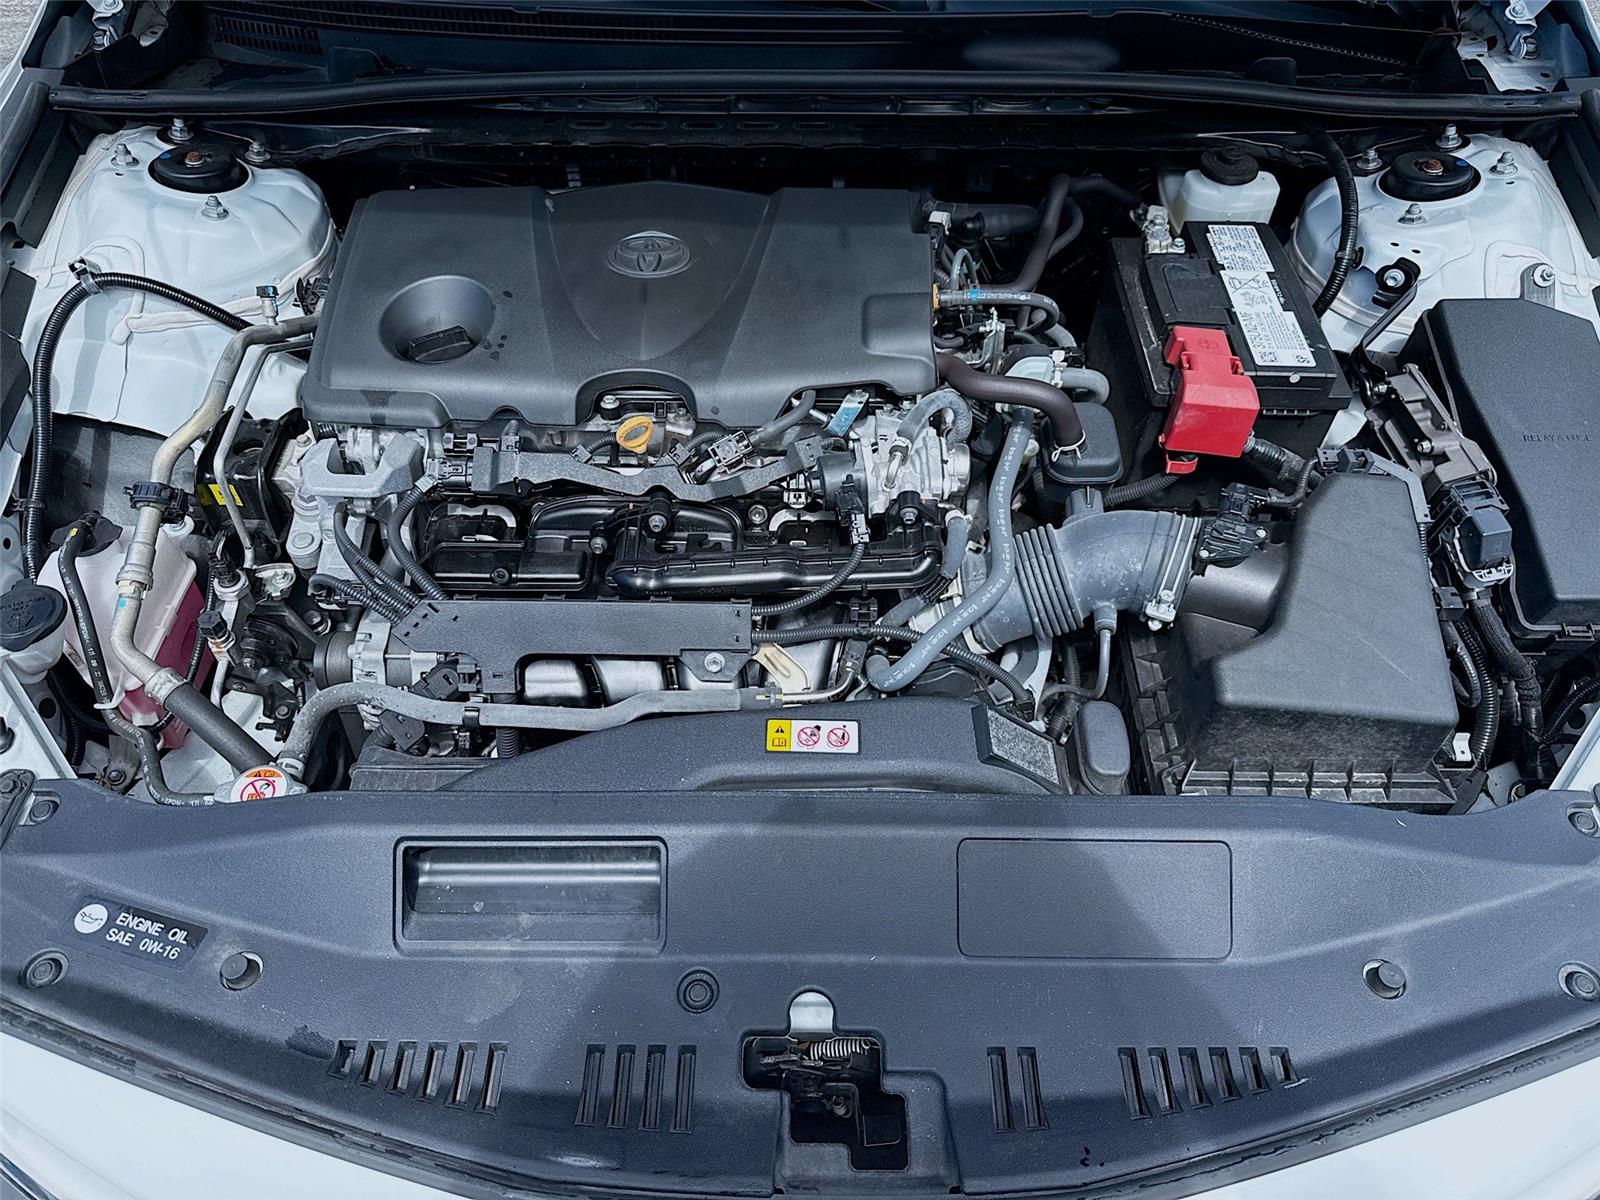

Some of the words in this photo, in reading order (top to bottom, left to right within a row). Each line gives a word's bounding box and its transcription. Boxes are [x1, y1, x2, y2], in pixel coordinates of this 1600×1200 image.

[1295, 354, 1311, 364] SP
[1522, 434, 1554, 442] RELAY
[116, 912, 164, 936] ENGINE
[168, 928, 188, 944] OIL
[106, 928, 135, 946] SAE
[139, 938, 180, 960] 0W-16
